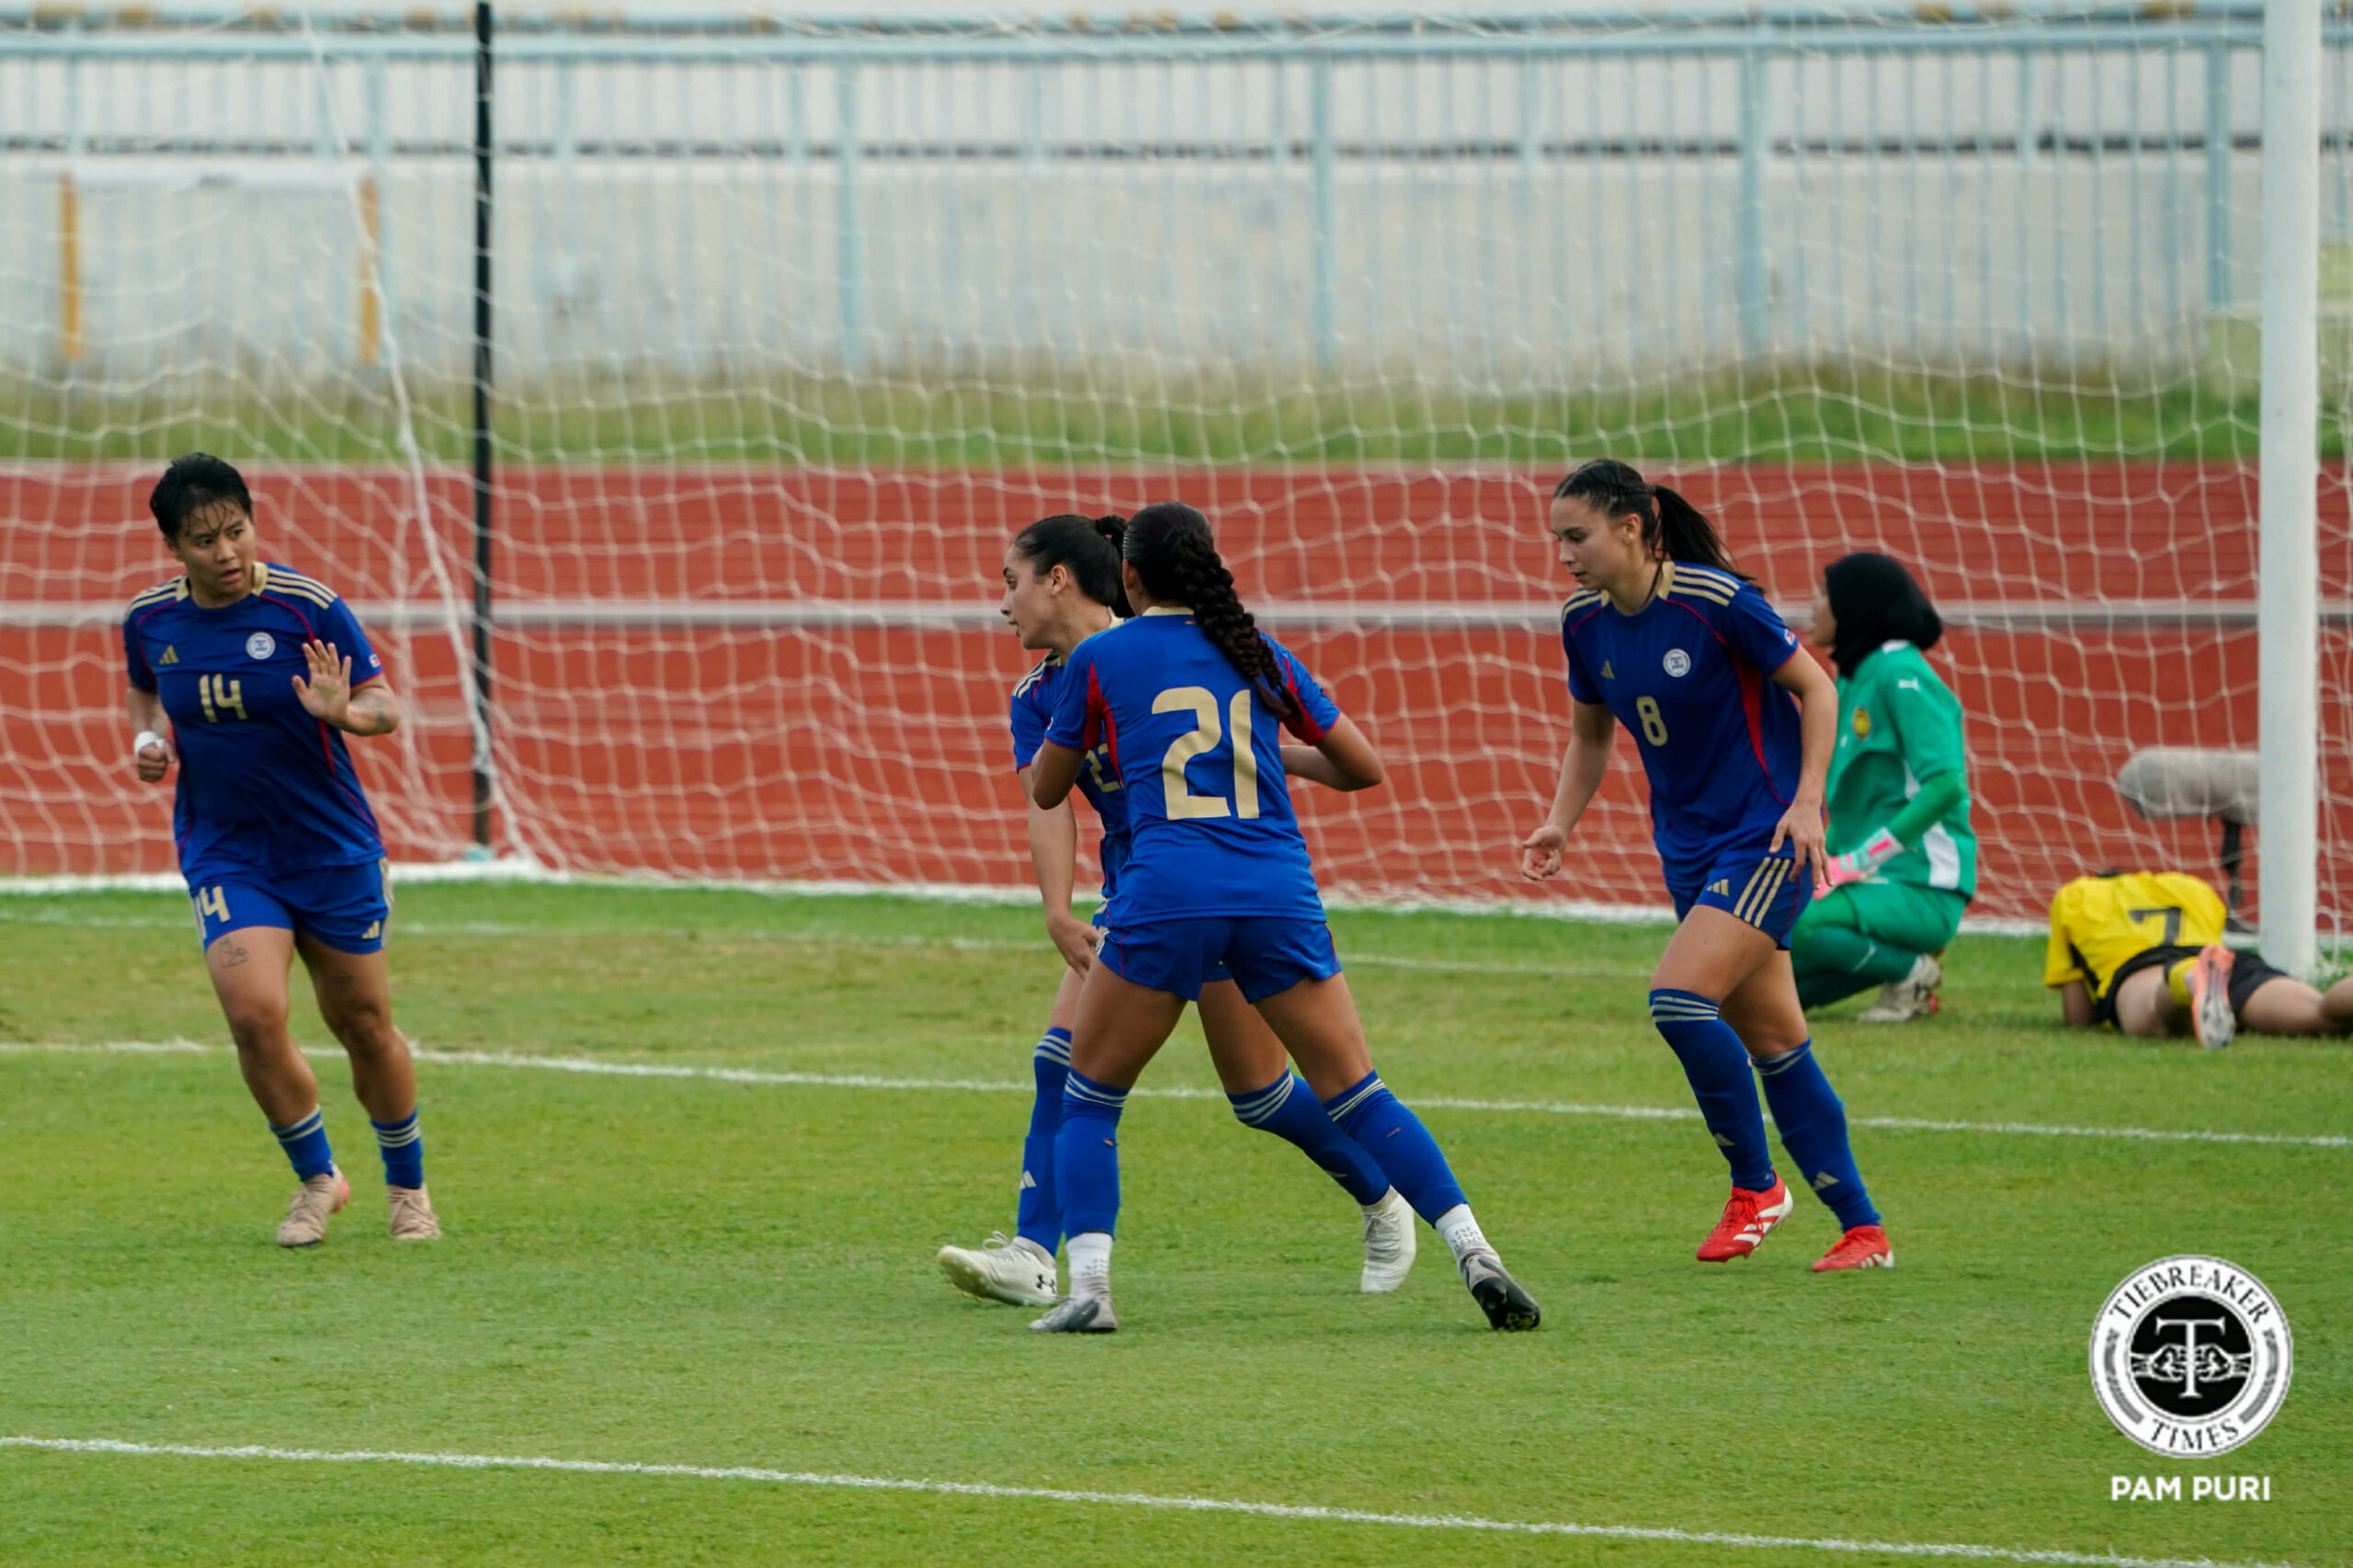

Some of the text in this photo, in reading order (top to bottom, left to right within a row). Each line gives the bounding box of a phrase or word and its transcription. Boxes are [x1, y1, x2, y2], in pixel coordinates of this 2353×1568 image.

[199, 673, 247, 722] 14
[1636, 695, 1668, 747] 8
[1086, 743, 1124, 792] 2
[1152, 686, 1260, 821] 21
[2129, 906, 2182, 945] 7
